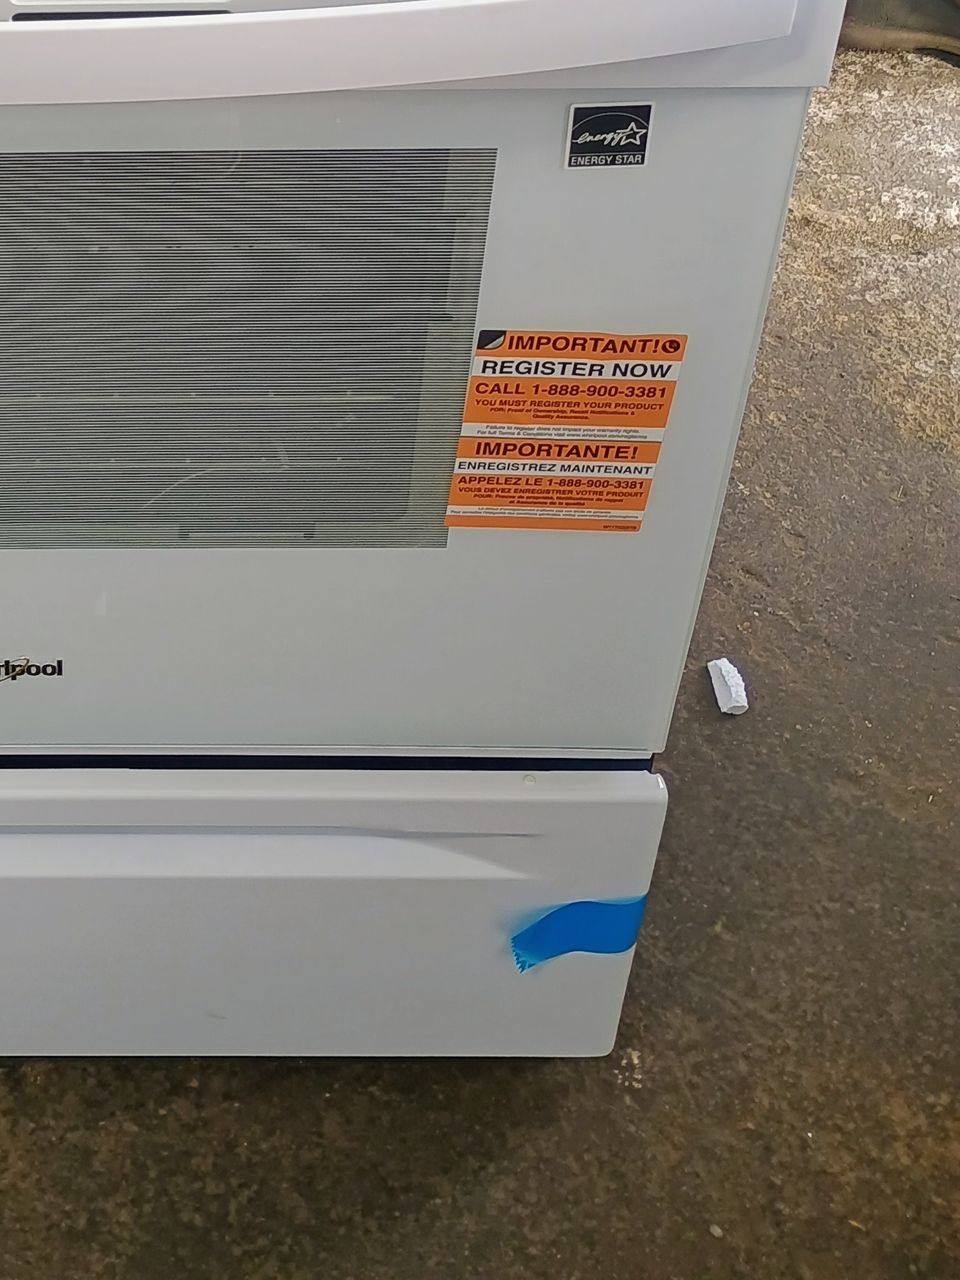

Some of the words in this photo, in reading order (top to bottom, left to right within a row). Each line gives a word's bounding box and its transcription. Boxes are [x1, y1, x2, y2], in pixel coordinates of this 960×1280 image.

[570, 155, 613, 166] ENERGY
[615, 154, 642, 165] STAR
[507, 335, 660, 354] IMPORTANT!
[481, 360, 605, 377] REGISTER
[612, 363, 673, 378] NOW
[475, 382, 525, 395] CALL
[531, 384, 666, 399] 1-888-900-3381
[475, 398, 497, 406] YOU
[499, 399, 527, 407] MUST
[530, 400, 581, 408] REGISTER
[583, 401, 612, 409] YOUR
[614, 402, 664, 411] PRODUCT
[475, 441, 638, 460] IMPORTANTE!
[458, 461, 556, 472] ENREGISTREZ
[559, 464, 652, 475] MAINTENANT
[458, 476, 522, 486] APPELEZ
[525, 477, 543, 486] LE
[547, 478, 644, 489] 1-888-900-3381
